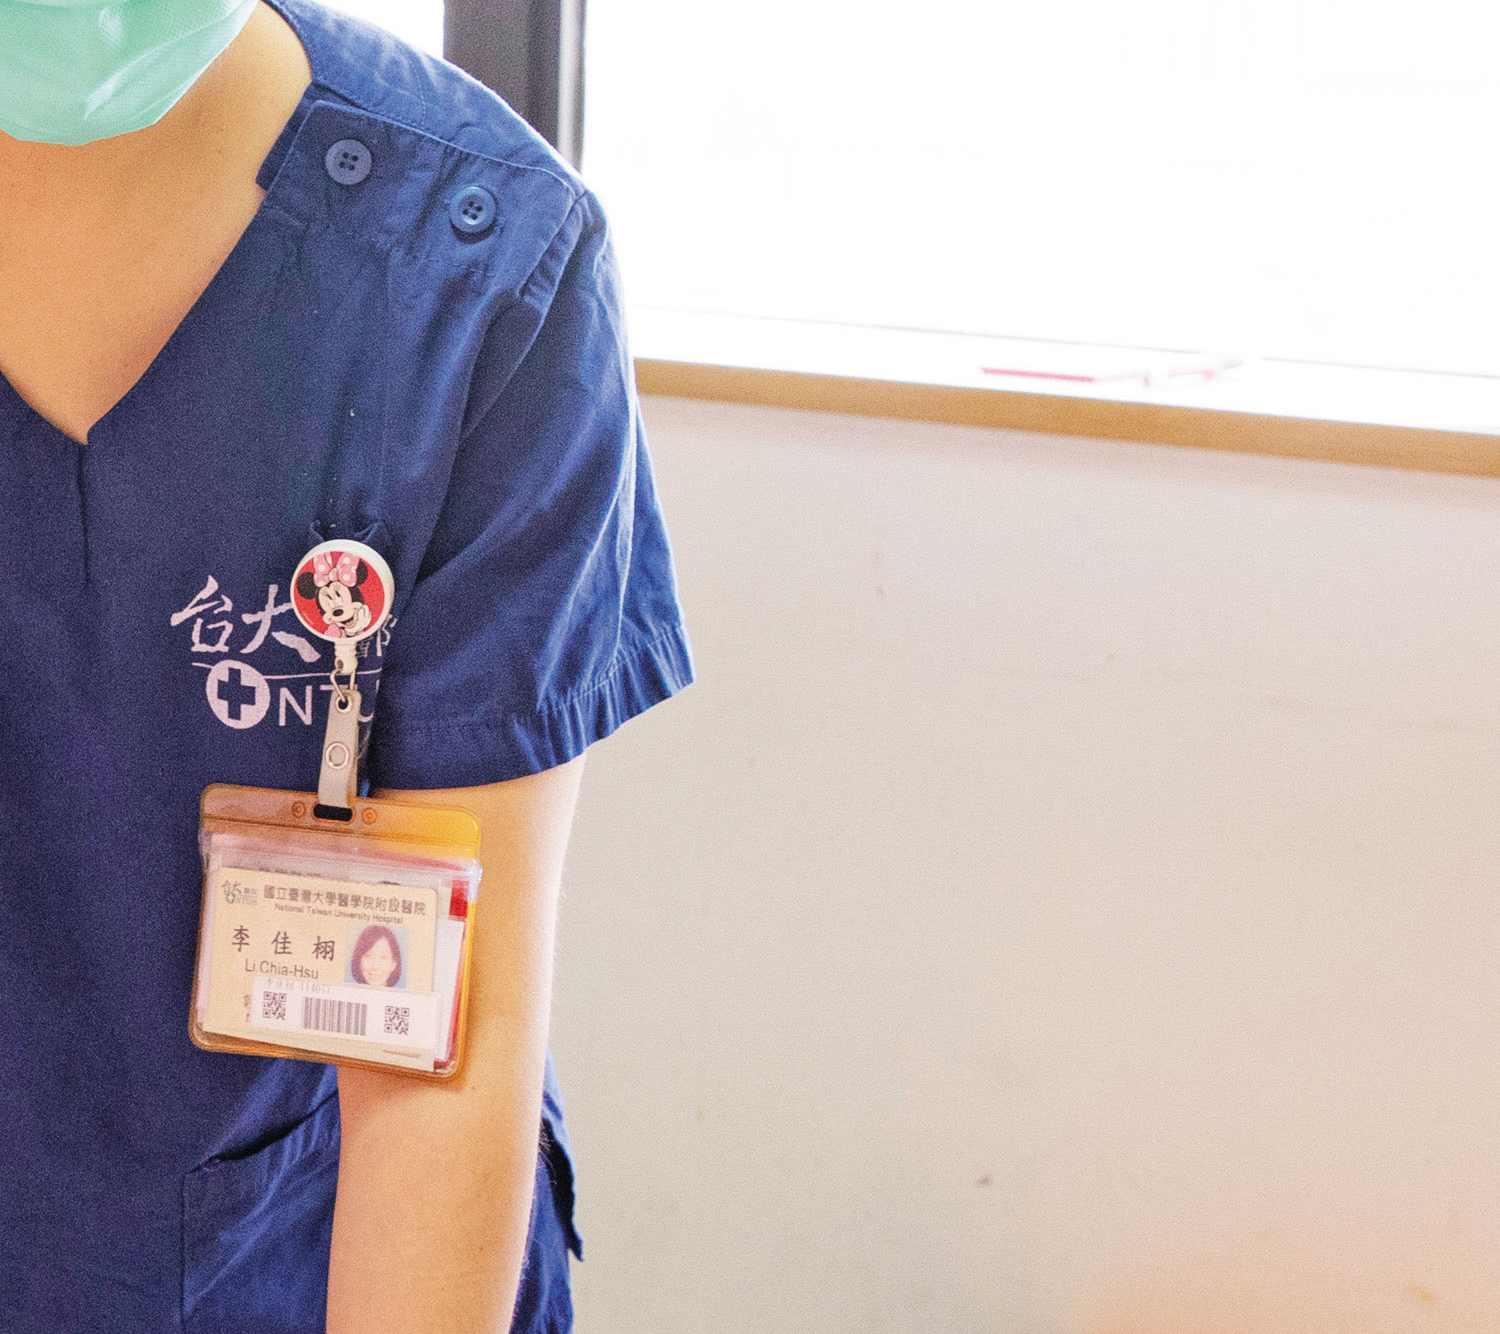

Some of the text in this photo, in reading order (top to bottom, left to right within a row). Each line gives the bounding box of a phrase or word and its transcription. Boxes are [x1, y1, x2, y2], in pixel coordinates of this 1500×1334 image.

[275, 903, 403, 923] National Taiwan University Hospital
